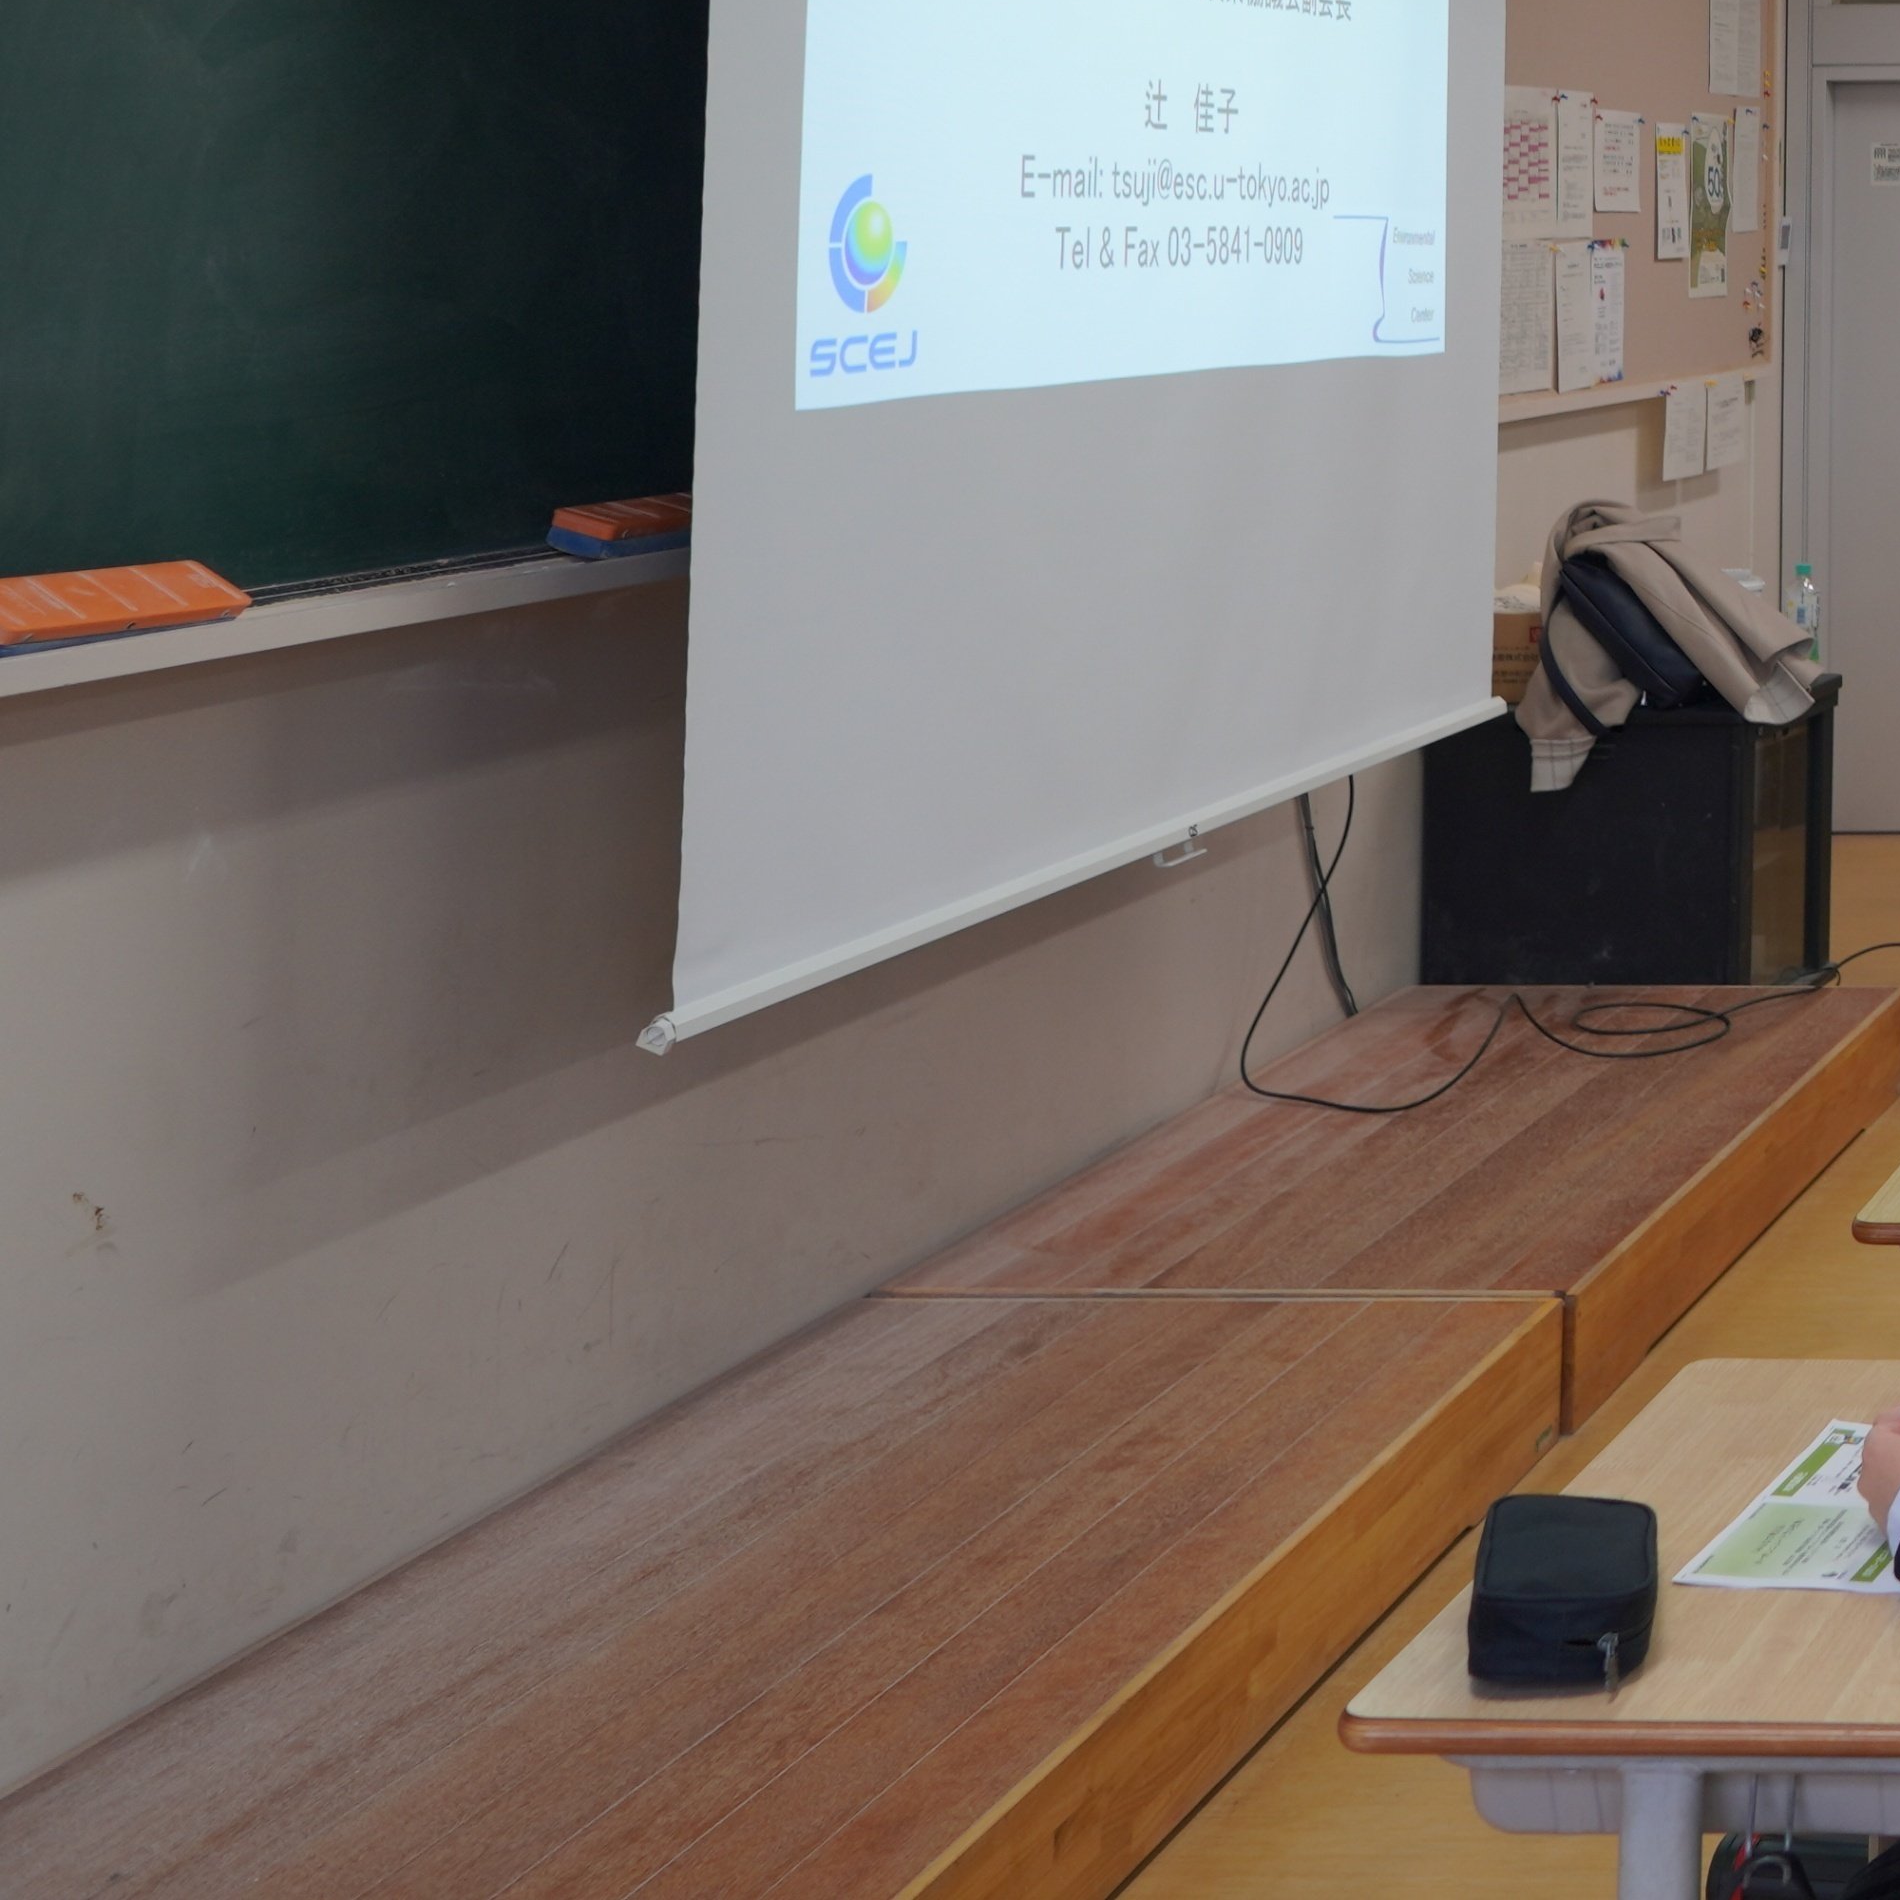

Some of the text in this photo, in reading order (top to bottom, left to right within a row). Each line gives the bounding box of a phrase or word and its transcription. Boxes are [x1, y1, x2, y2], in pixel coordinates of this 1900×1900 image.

[1144, 79, 1239, 135] 辻 佳子
[1021, 154, 1330, 210] E-mail: tsuji@esc.u-tokyo.ac.jp
[1055, 226, 1304, 269] Tel & Fax 03-5841-0909
[809, 329, 918, 378] SCEJ
